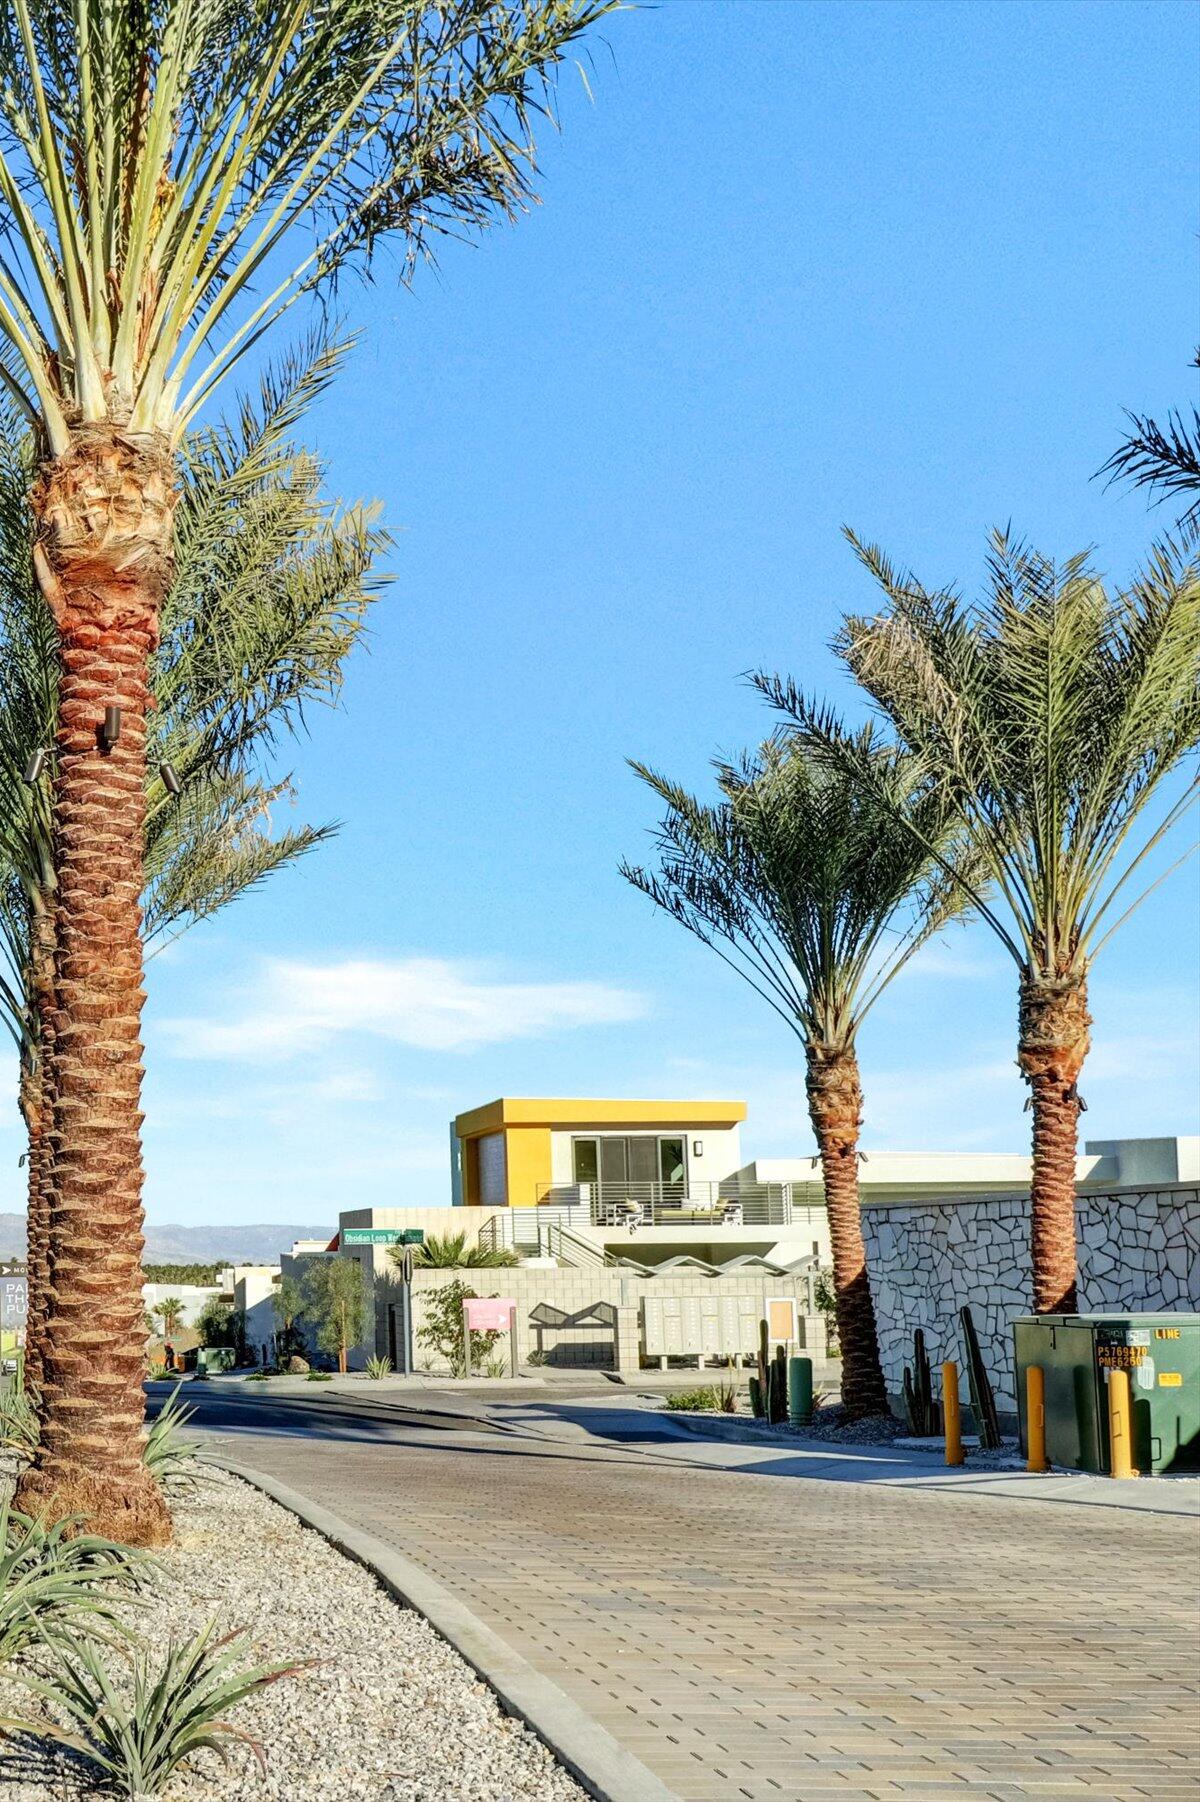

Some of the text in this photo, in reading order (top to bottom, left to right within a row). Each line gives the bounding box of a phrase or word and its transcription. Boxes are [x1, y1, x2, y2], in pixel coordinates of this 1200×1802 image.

[371, 1234, 387, 1244] Loop
[6, 1284, 28, 1293] PA
[5, 1294, 28, 1303] TH
[6, 1305, 28, 1314] PU
